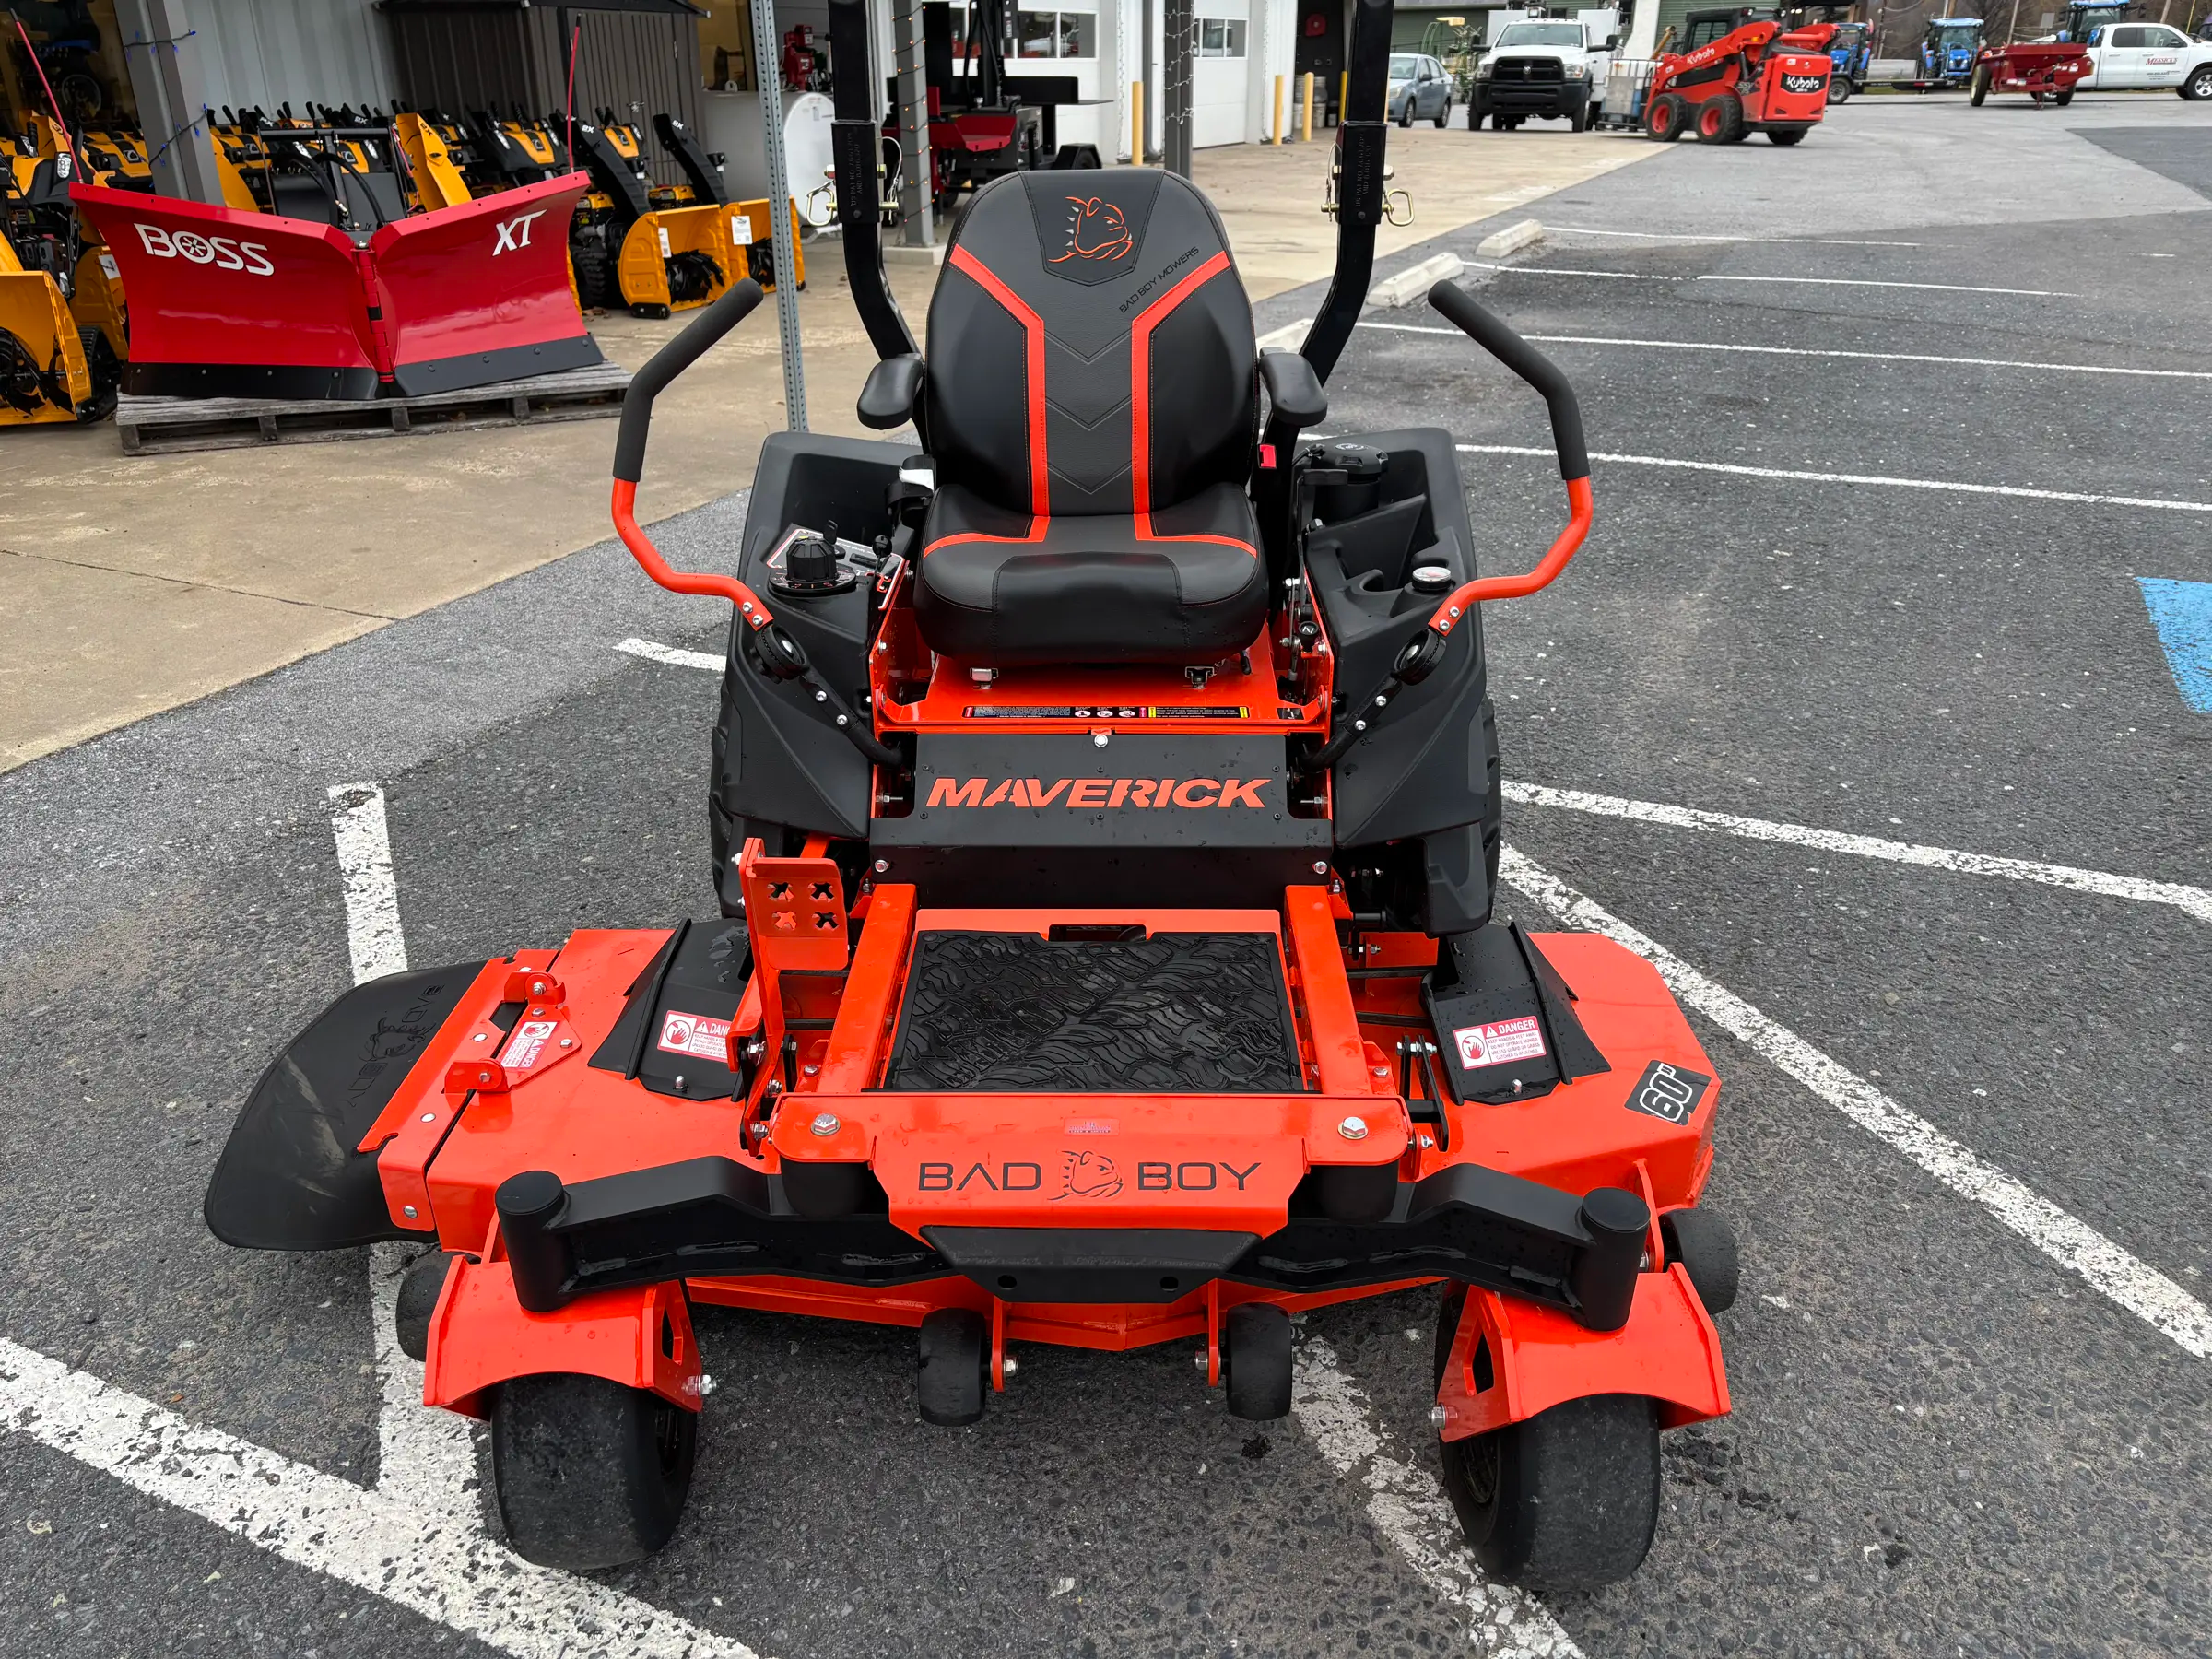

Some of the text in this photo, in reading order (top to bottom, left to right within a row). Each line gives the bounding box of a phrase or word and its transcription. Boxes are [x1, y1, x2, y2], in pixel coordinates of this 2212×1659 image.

[1687, 47, 1715, 65] Kubota
[1786, 76, 1819, 88] Kubota
[492, 209, 548, 257] XT
[134, 222, 275, 276] BOSS
[1119, 246, 1199, 313] BAD BOY MOWERS
[925, 778, 1274, 808] MAVERICK
[710, 1023, 731, 1036] DAN
[1498, 1019, 1535, 1034] DANGER
[338, 984, 445, 1108] BAD BOY
[918, 1162, 1262, 1191] BAD BOY
